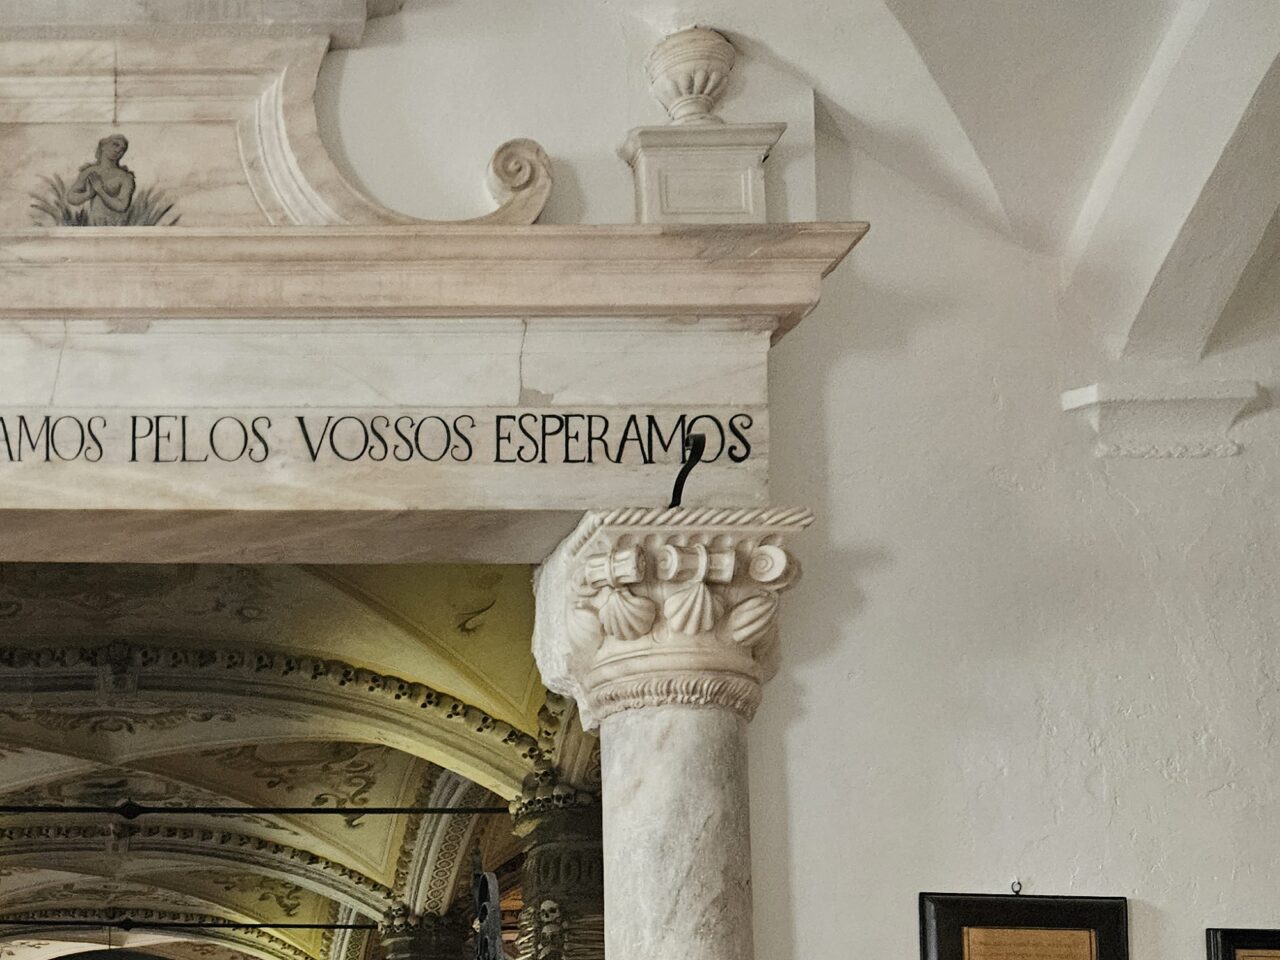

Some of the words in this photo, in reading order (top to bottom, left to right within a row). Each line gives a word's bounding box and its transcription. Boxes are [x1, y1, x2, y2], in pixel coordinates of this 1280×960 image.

[129, 414, 272, 464] PELOS
[295, 414, 479, 464] VOSSOS
[494, 412, 754, 465] ESPERAMOS
